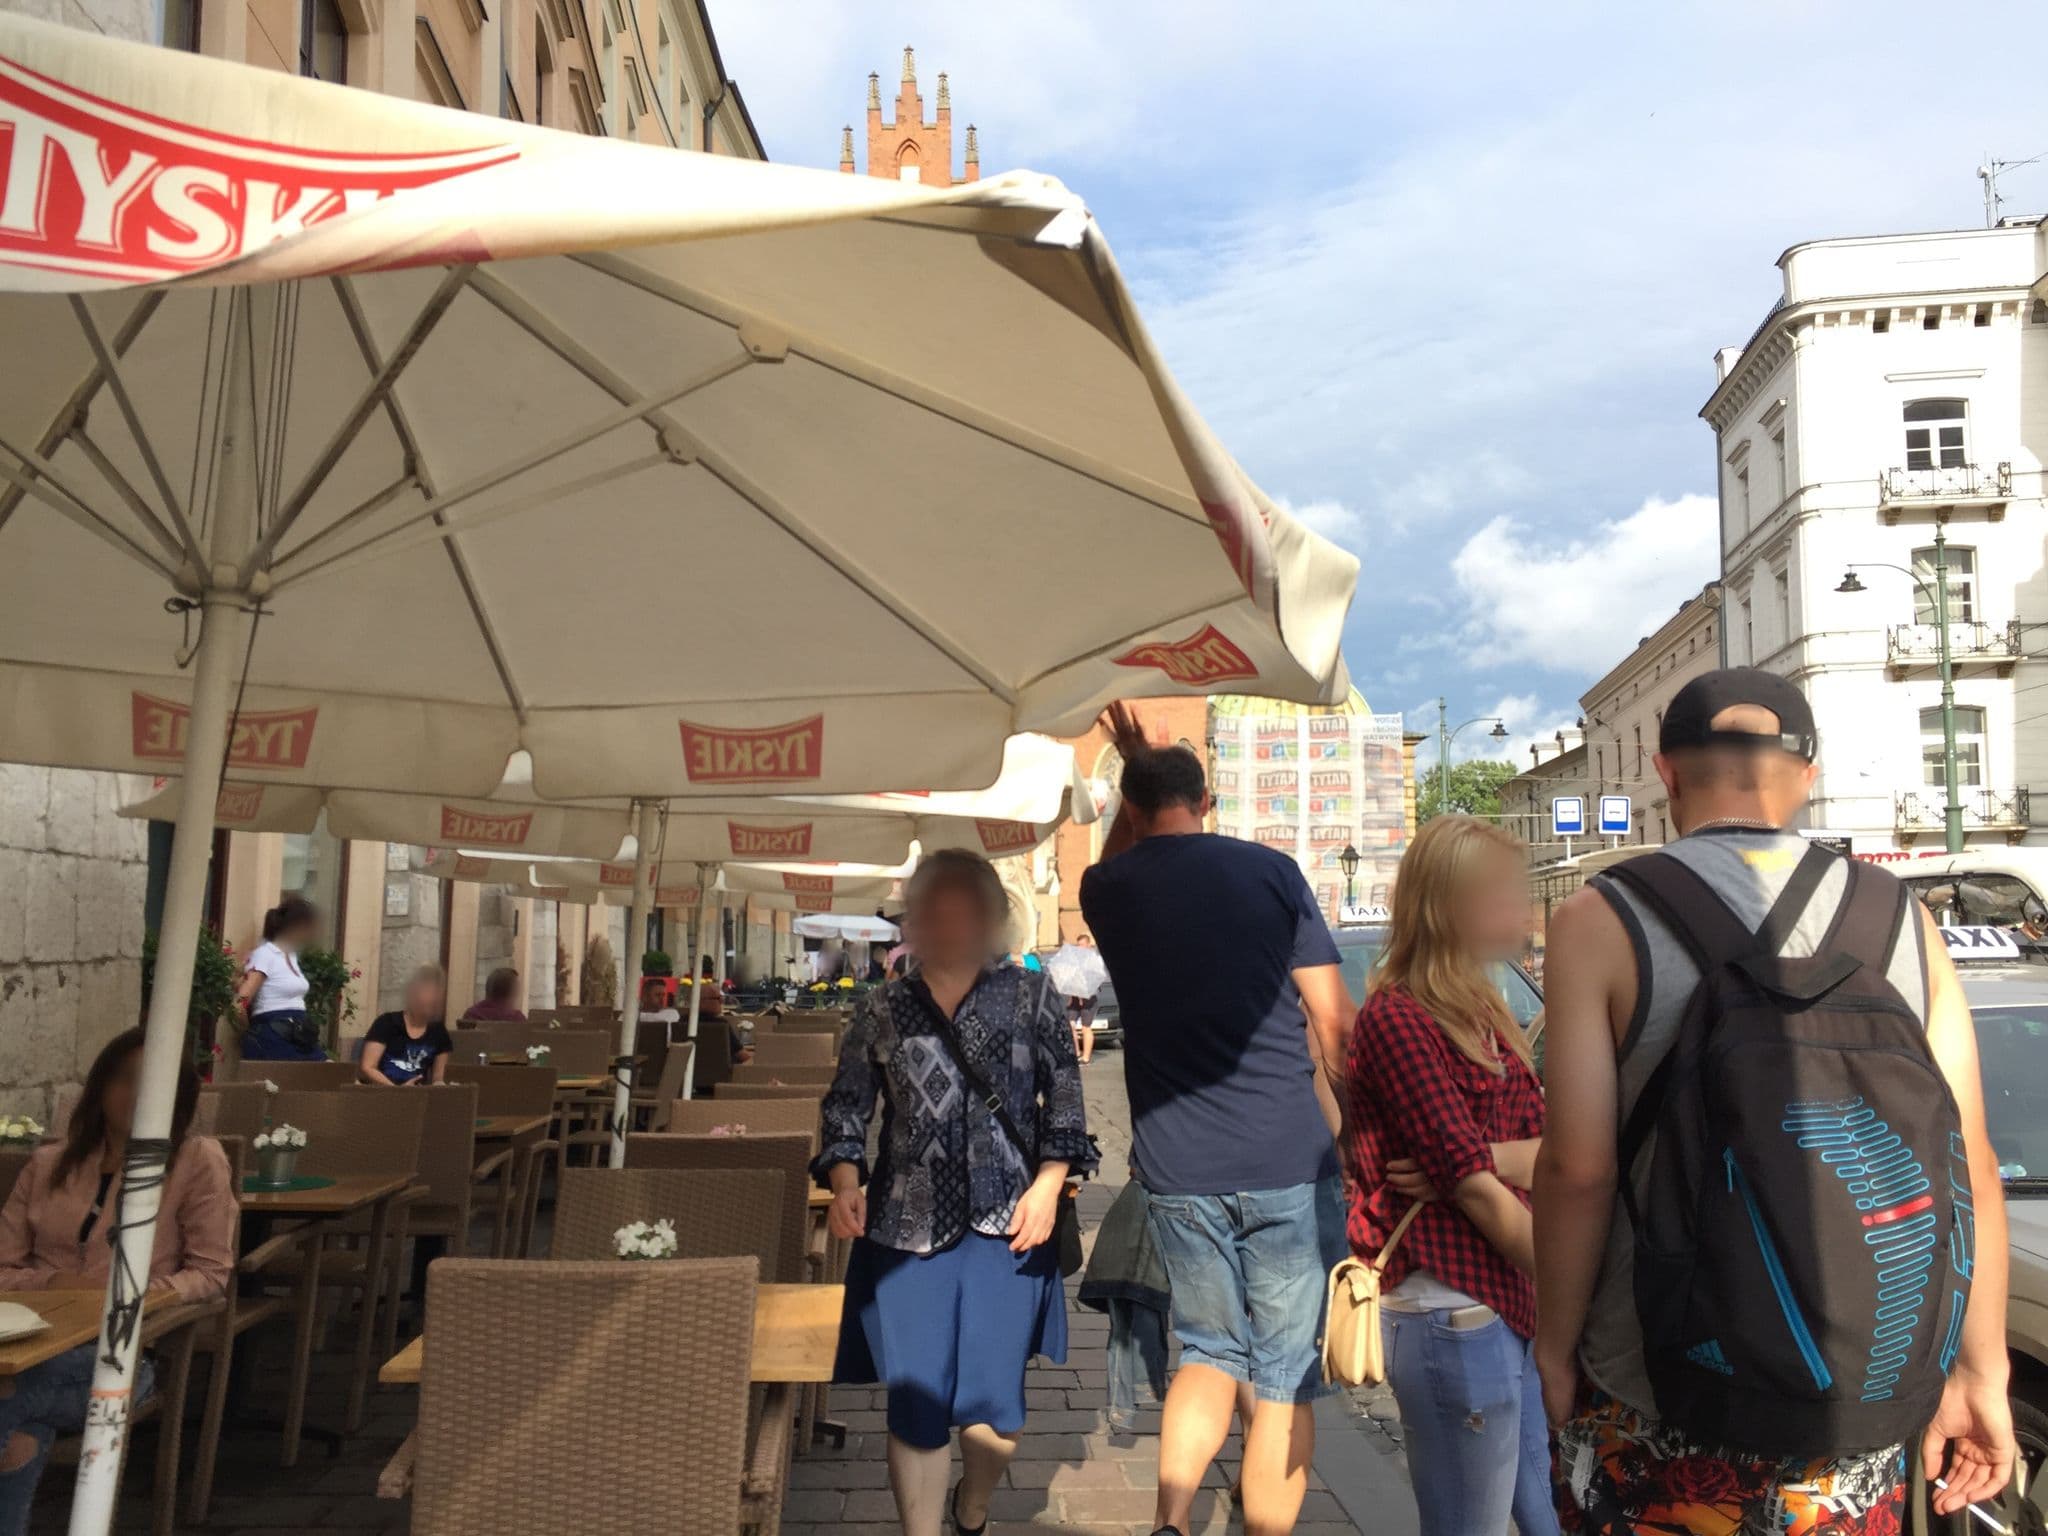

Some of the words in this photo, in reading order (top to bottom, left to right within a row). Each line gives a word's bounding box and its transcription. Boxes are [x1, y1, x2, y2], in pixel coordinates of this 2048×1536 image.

[0, 98, 415, 262] TYSK
[1260, 772, 1296, 787] TYTAN
[1311, 772, 1348, 786] TYTAN
[1350, 906, 1389, 917] TAXI
[1939, 928, 2008, 948] AXI
